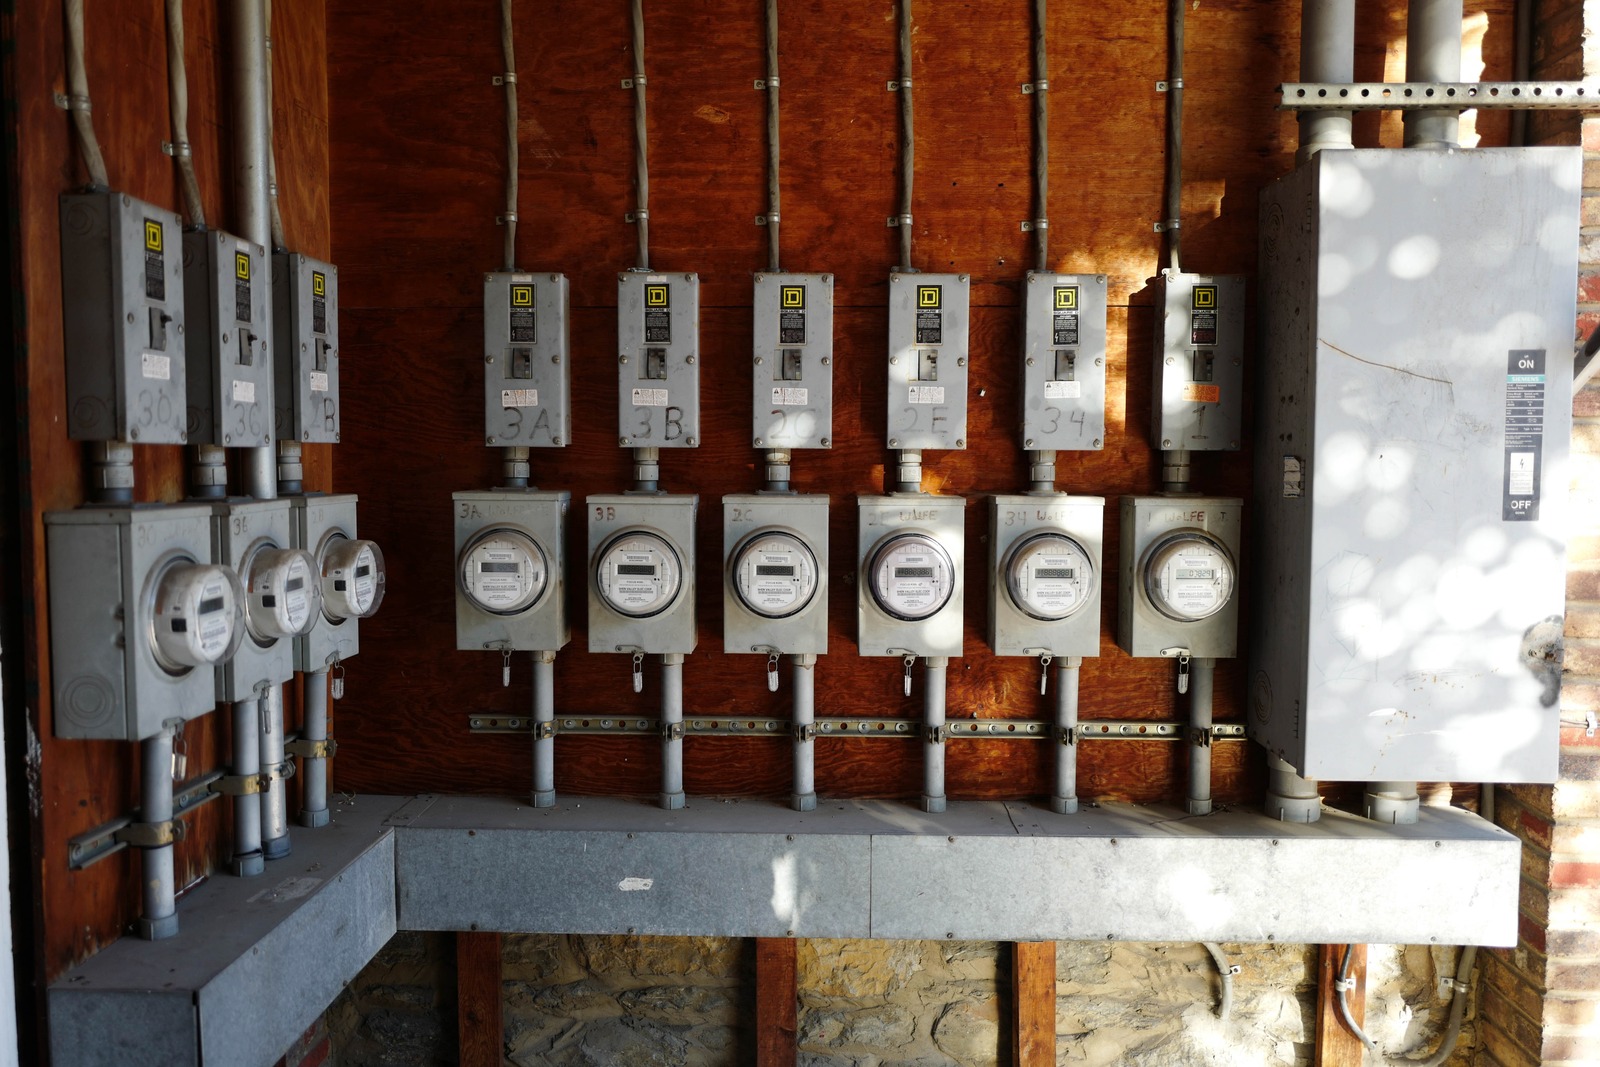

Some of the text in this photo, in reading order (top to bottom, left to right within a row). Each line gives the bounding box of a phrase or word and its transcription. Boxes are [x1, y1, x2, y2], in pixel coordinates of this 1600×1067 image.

[1518, 360, 1534, 368] ON
[1511, 500, 1531, 509] OFF
[460, 503, 481, 519] 3A
[595, 506, 615, 521] 3B
